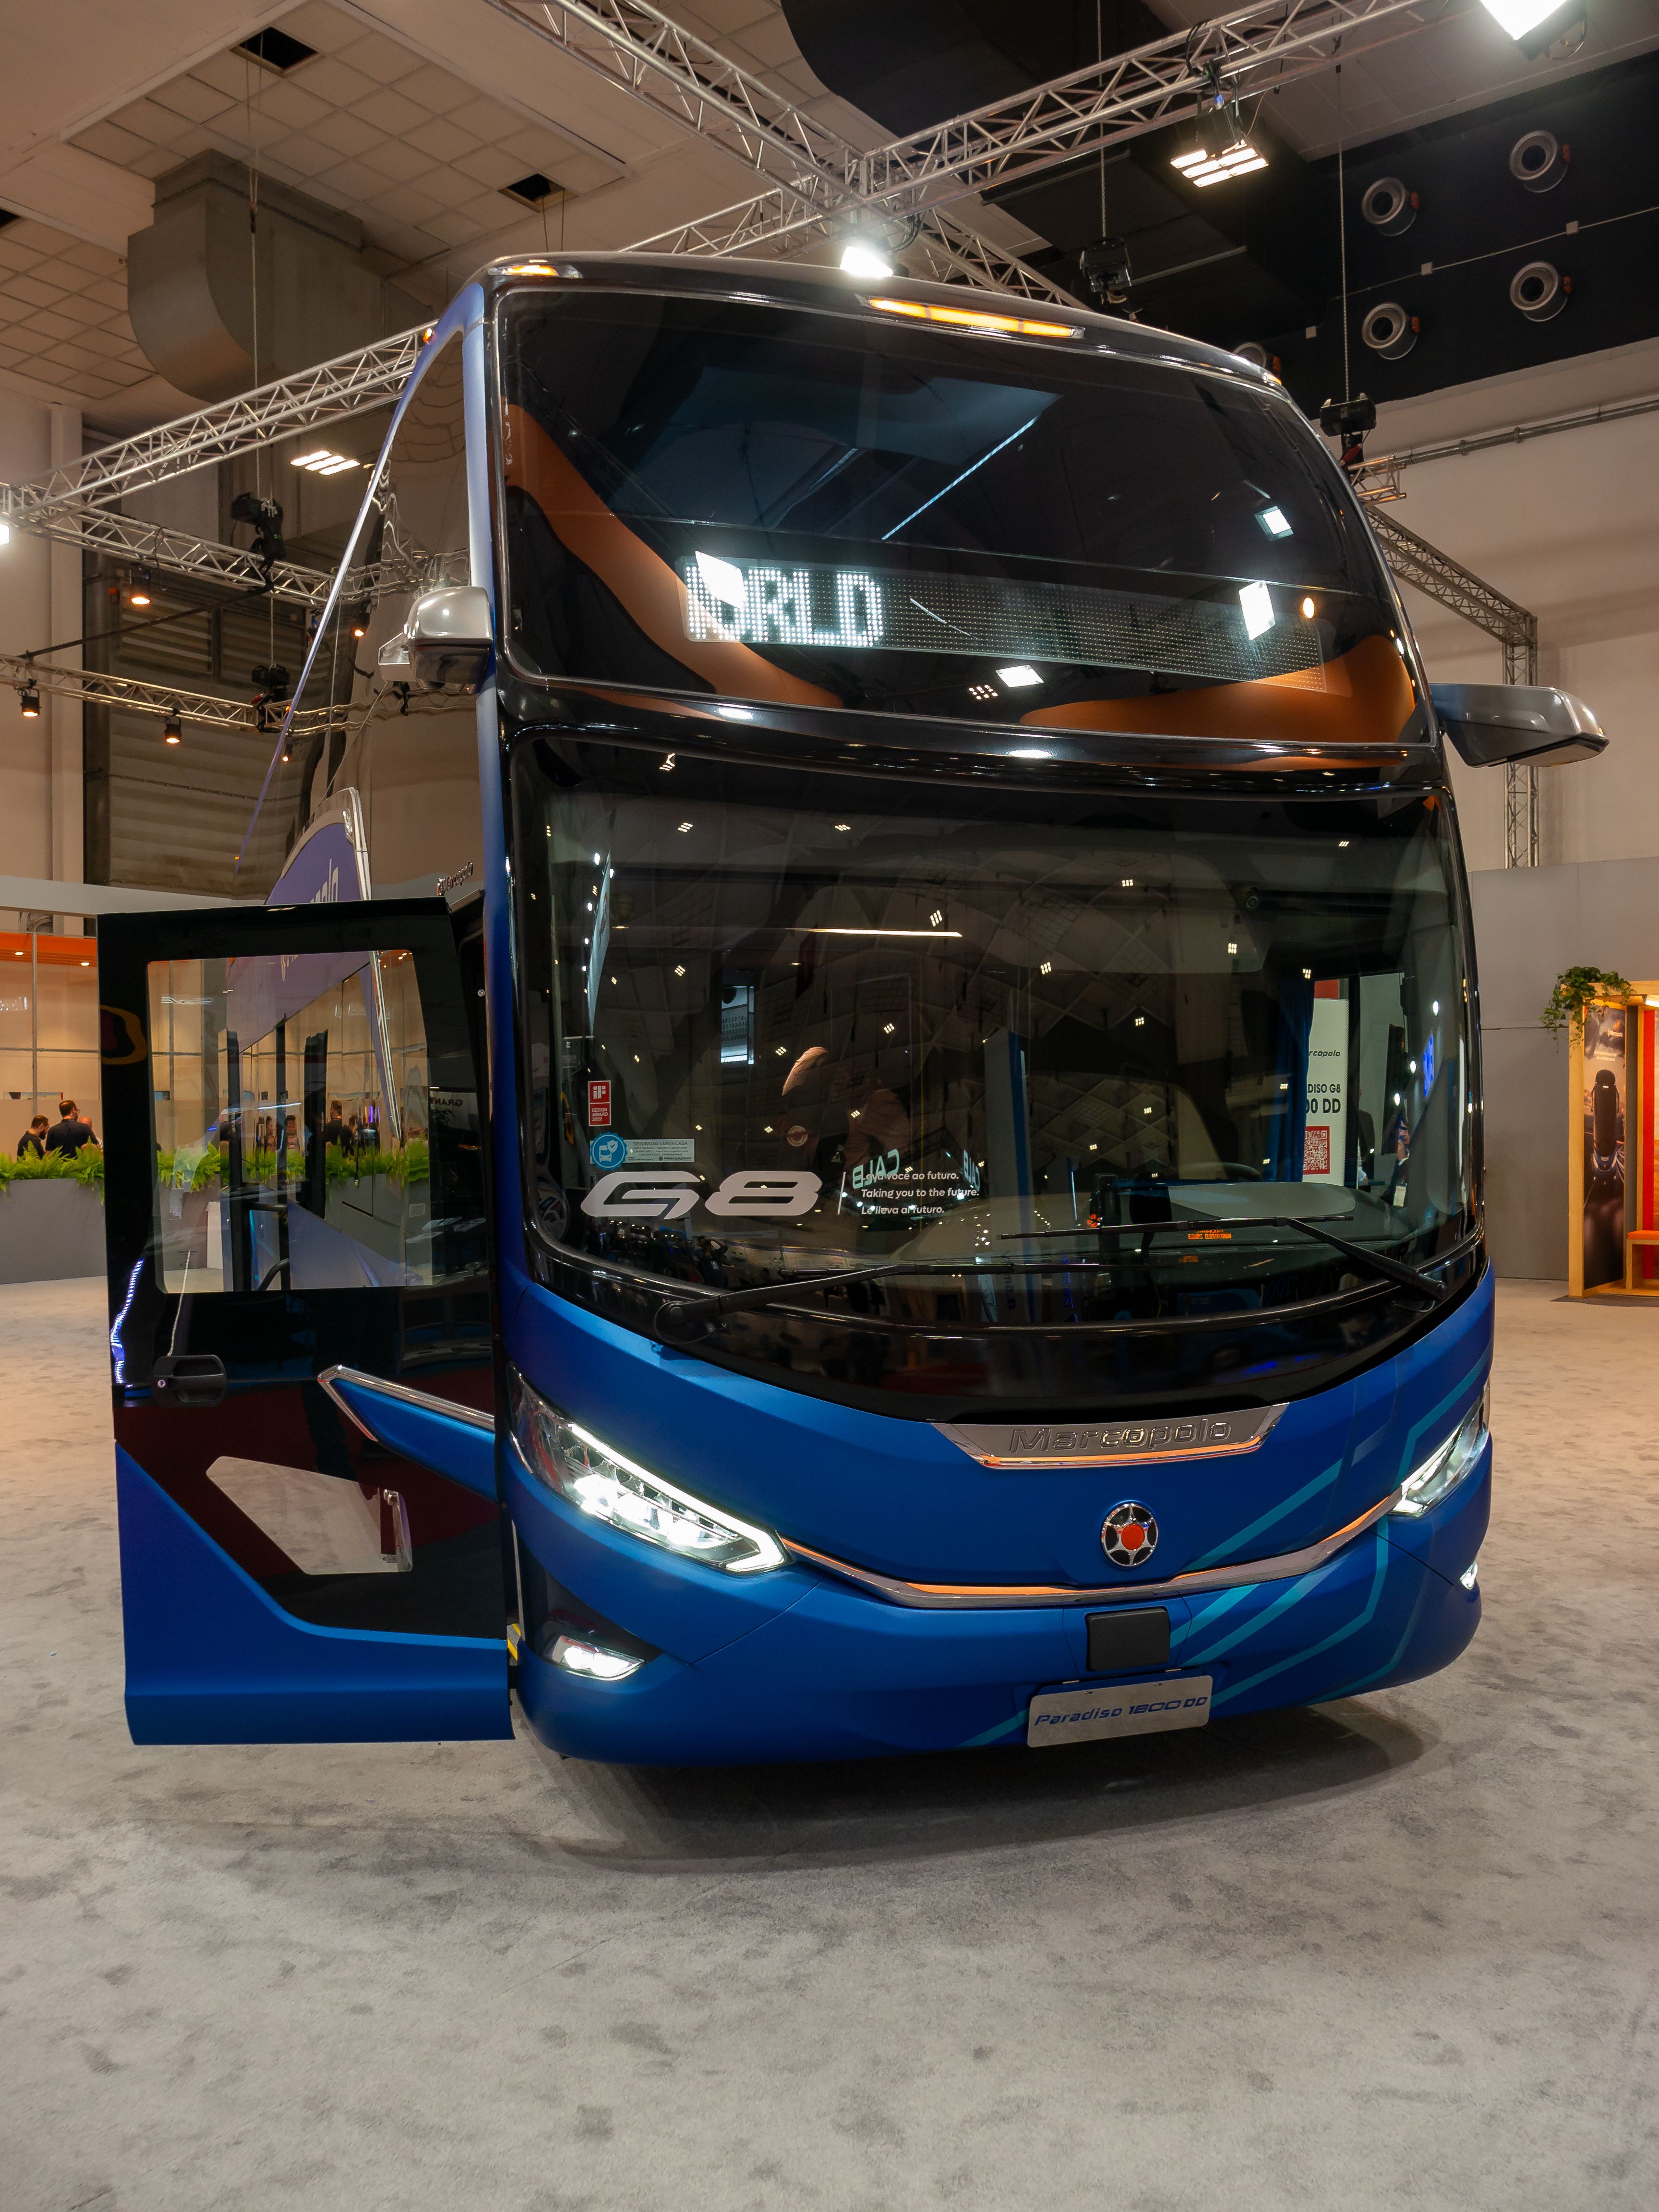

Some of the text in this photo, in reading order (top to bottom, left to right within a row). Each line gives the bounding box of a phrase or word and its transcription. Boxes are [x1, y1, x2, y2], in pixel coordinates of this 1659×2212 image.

[1307, 1083, 1341, 1093] DISO G8
[1323, 1098, 1341, 1114] DD
[887, 1172, 910, 1180] você
[927, 1171, 959, 1180] futuro.
[581, 1171, 822, 1219] G8
[861, 1189, 893, 1198] Taking
[895, 1190, 914, 1198] you
[862, 1205, 944, 1214] Le lleva al futuro.
[1009, 1419, 1231, 1453] Marcopolo
[1034, 1696, 1208, 1727] Paradiso 1800 DD
